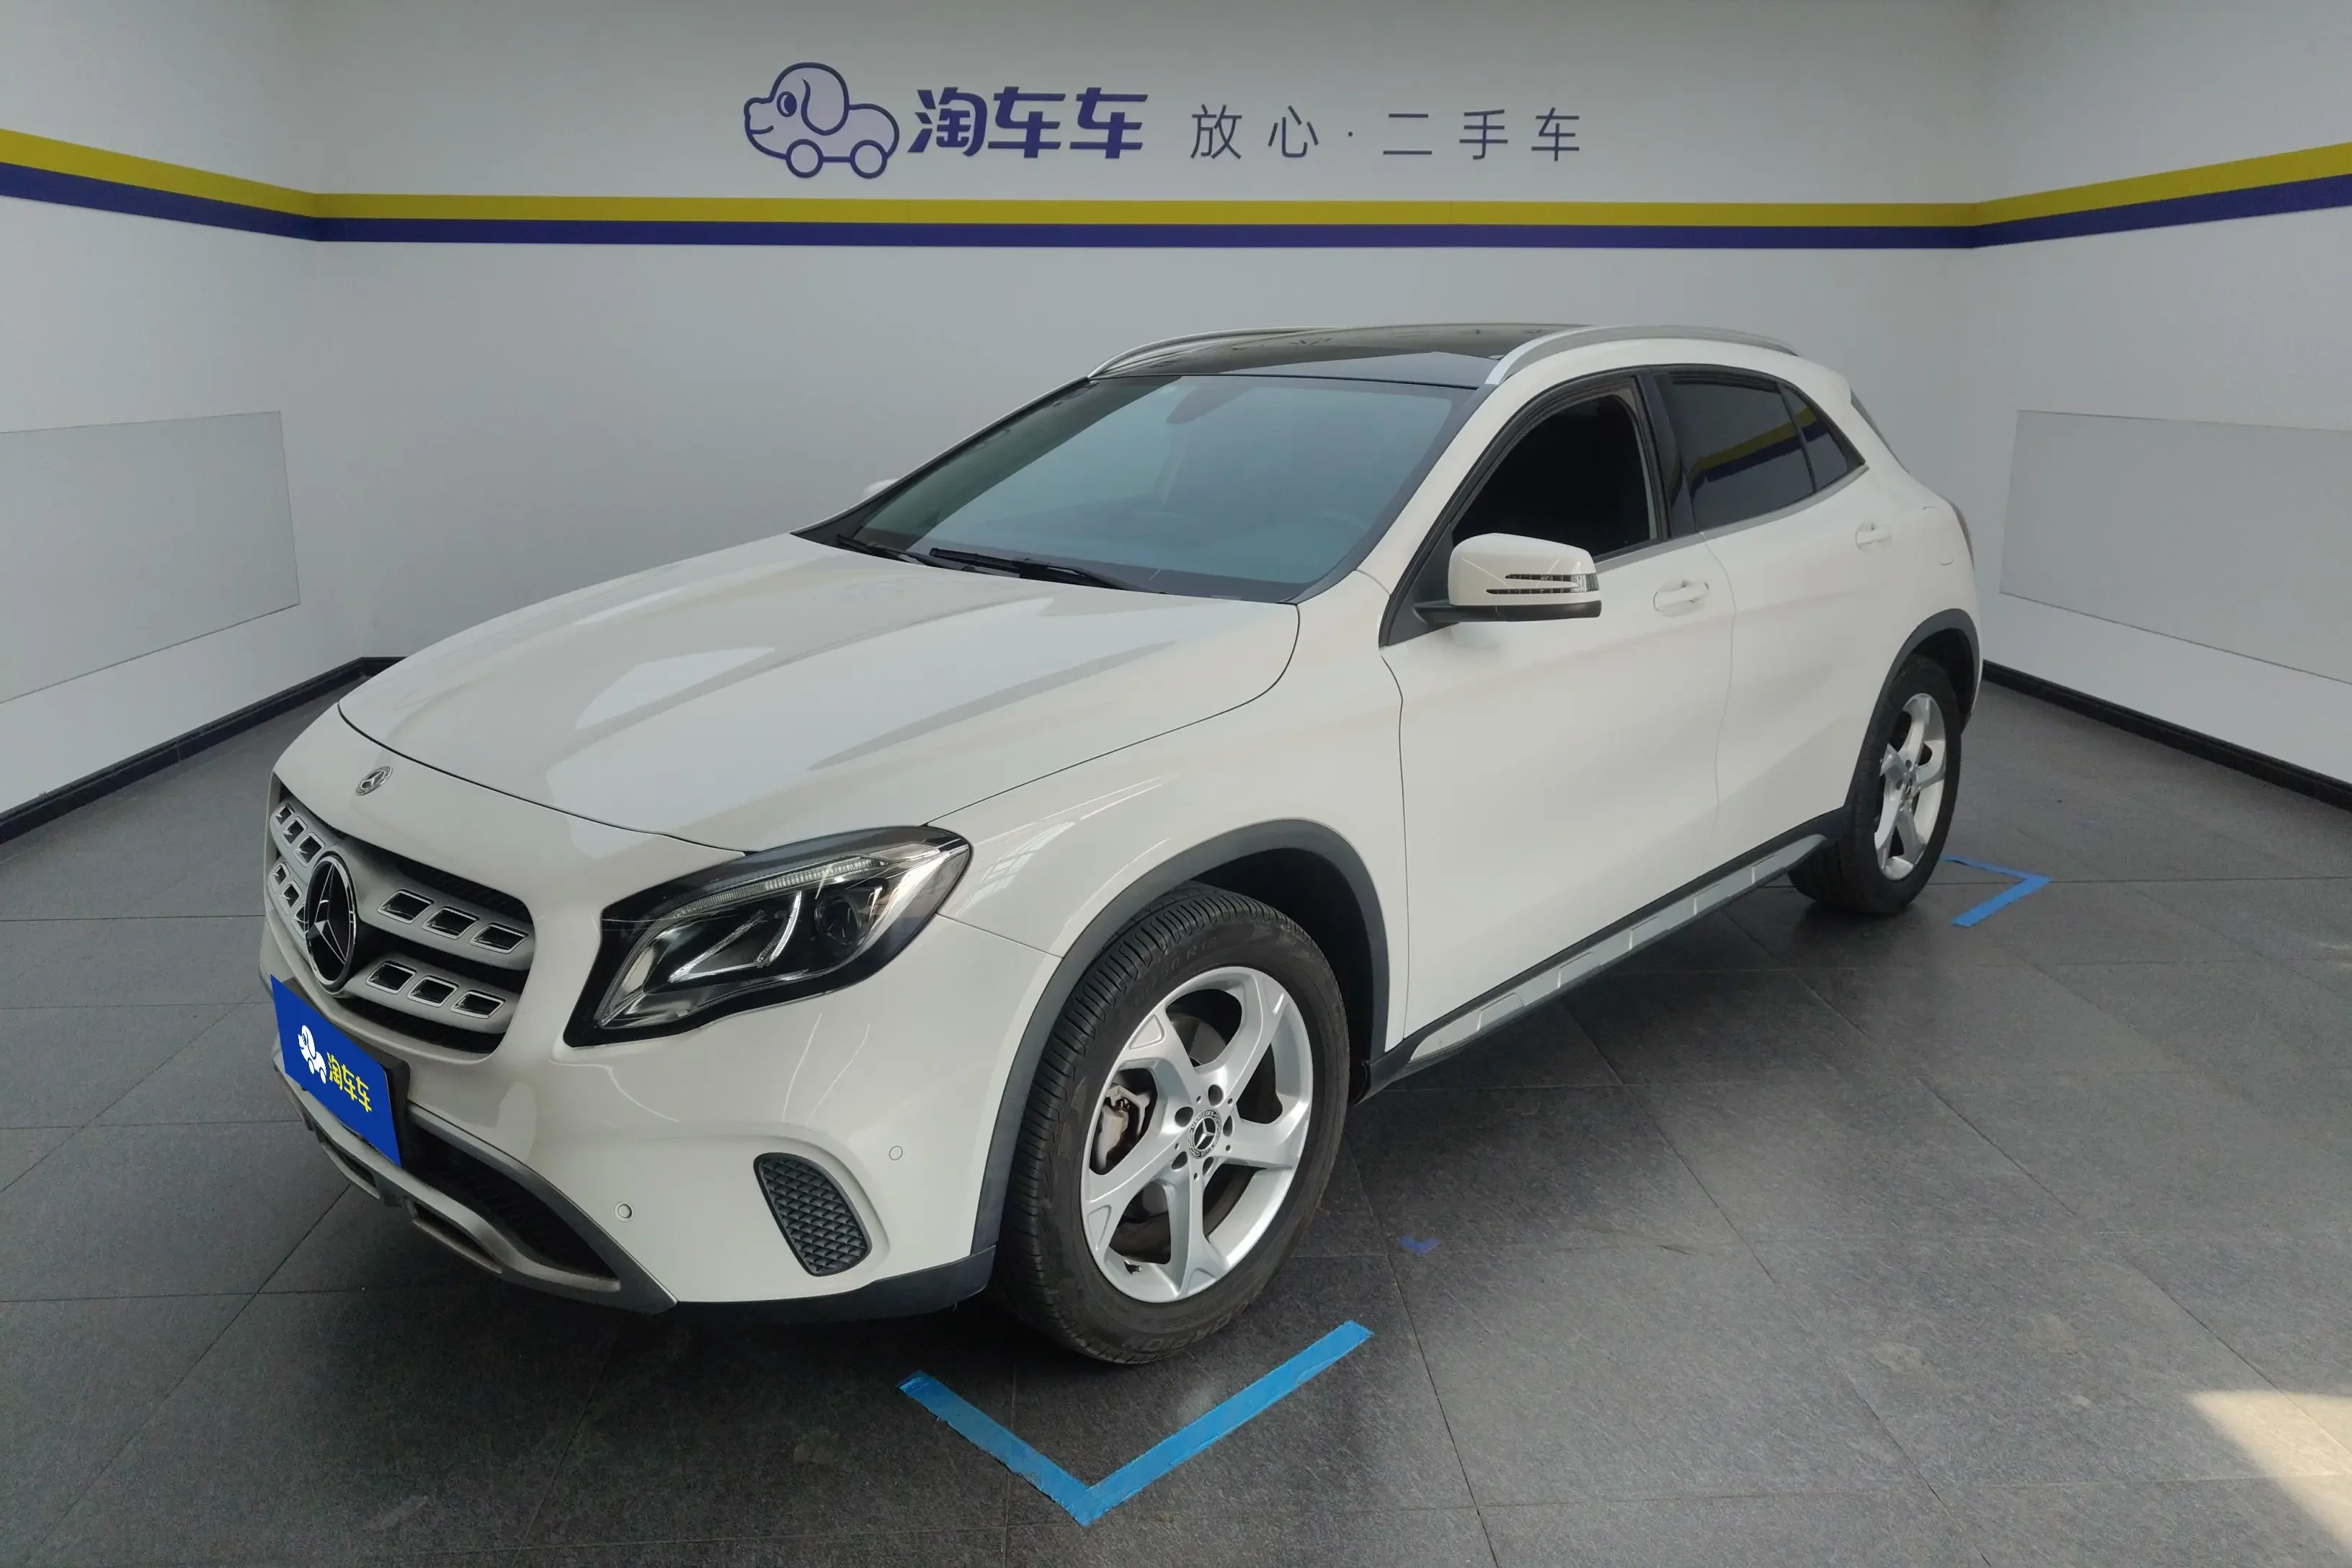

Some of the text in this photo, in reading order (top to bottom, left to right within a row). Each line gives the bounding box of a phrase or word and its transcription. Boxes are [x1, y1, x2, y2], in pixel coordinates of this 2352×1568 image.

[907, 86, 1149, 159] 淘车车
[1190, 103, 1580, 162] 放心·二手车
